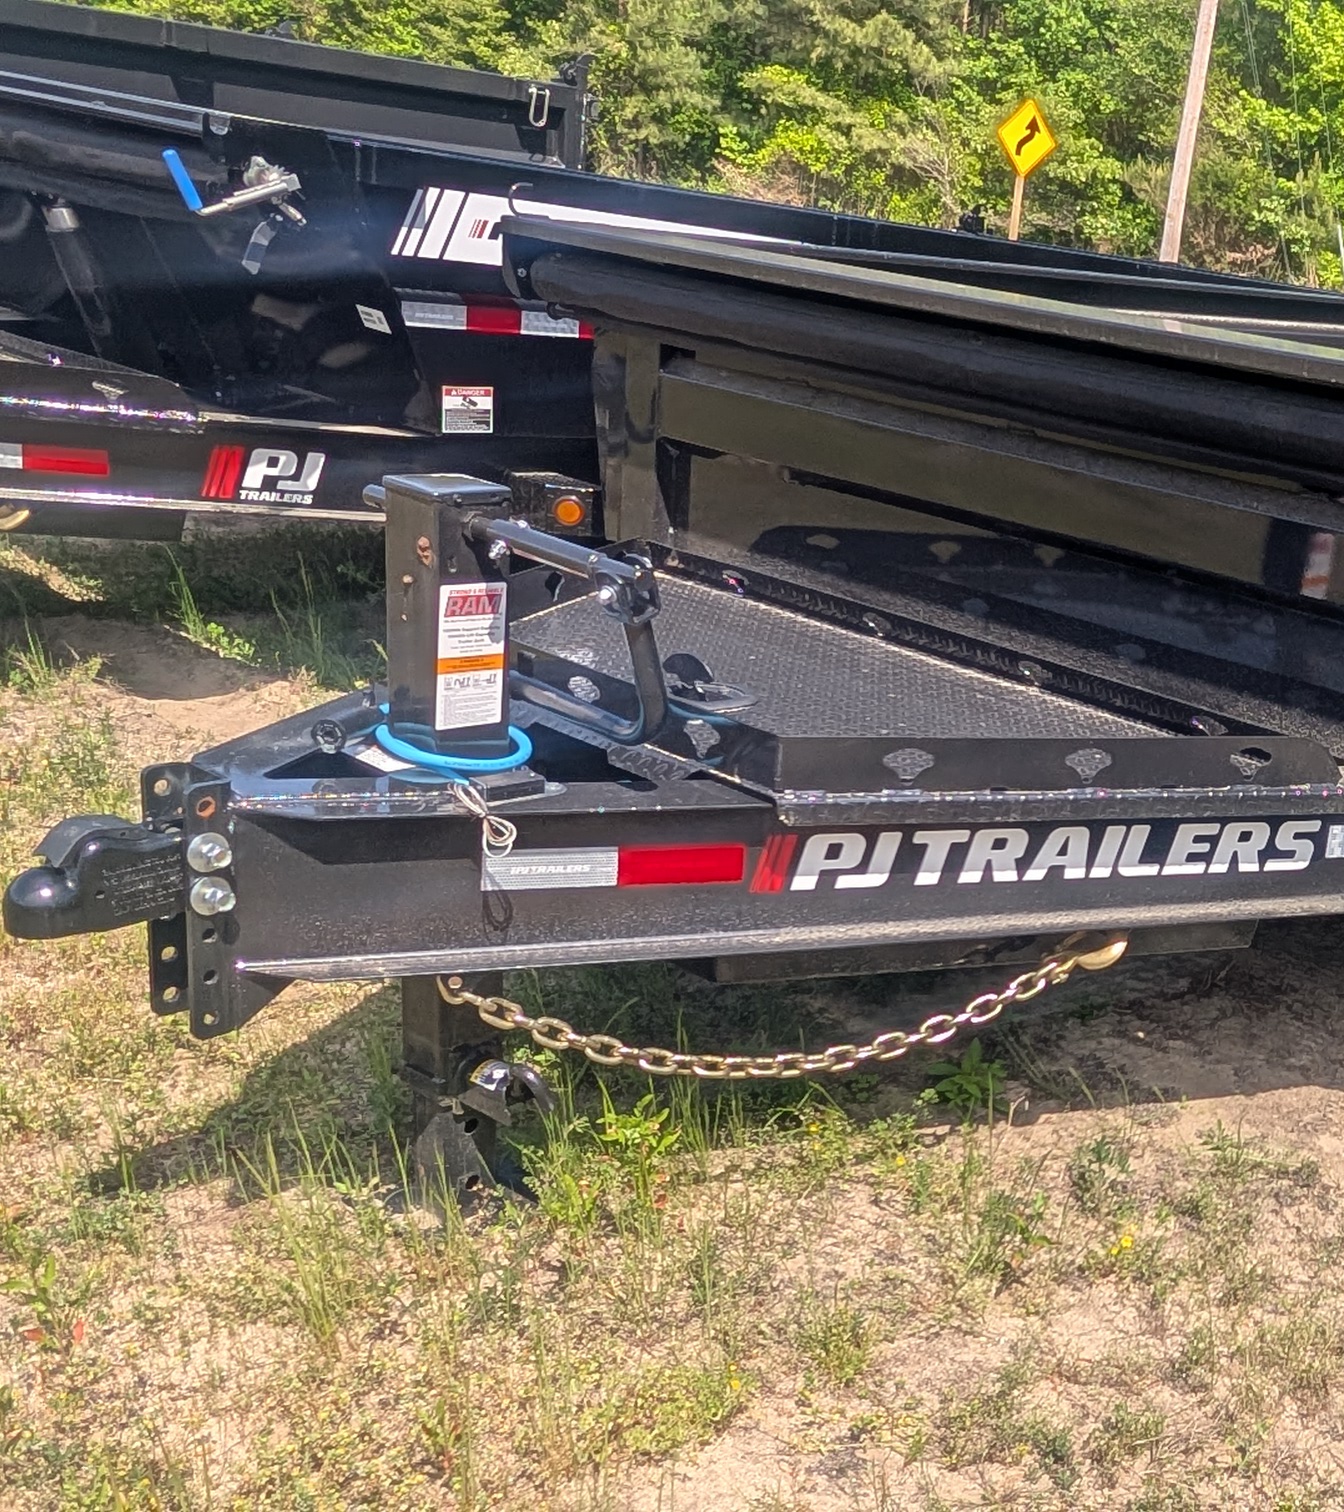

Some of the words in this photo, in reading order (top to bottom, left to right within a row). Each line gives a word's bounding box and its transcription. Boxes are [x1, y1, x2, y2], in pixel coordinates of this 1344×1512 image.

[241, 447, 326, 492] PJ
[239, 490, 314, 505] TRAILERS
[446, 595, 501, 617] RAM
[789, 831, 904, 891] PJ
[912, 819, 1322, 887] TRAILERS
